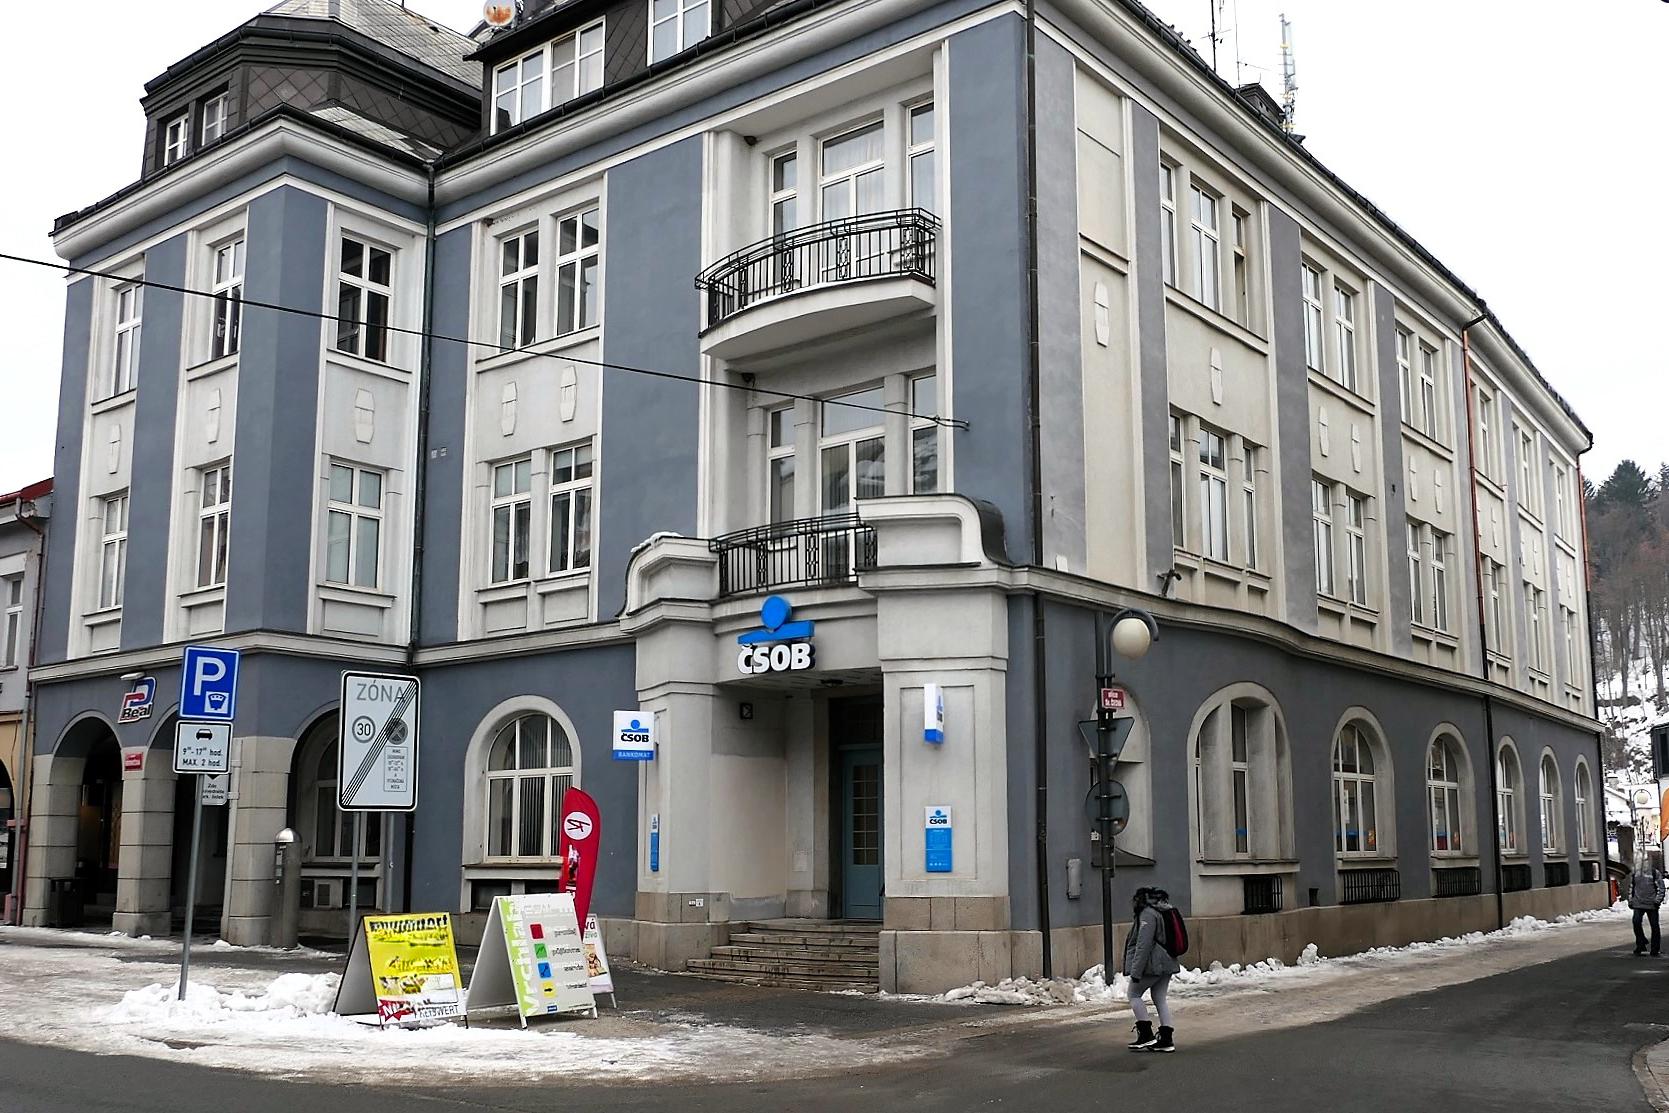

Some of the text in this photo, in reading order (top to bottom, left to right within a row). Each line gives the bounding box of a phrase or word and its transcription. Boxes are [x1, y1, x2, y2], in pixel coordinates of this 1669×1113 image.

[737, 643, 812, 674] ČSOB
[193, 656, 226, 696] P
[356, 680, 407, 702] ZÓNA
[357, 723, 371, 736] 30
[621, 733, 649, 742] ČSOB
